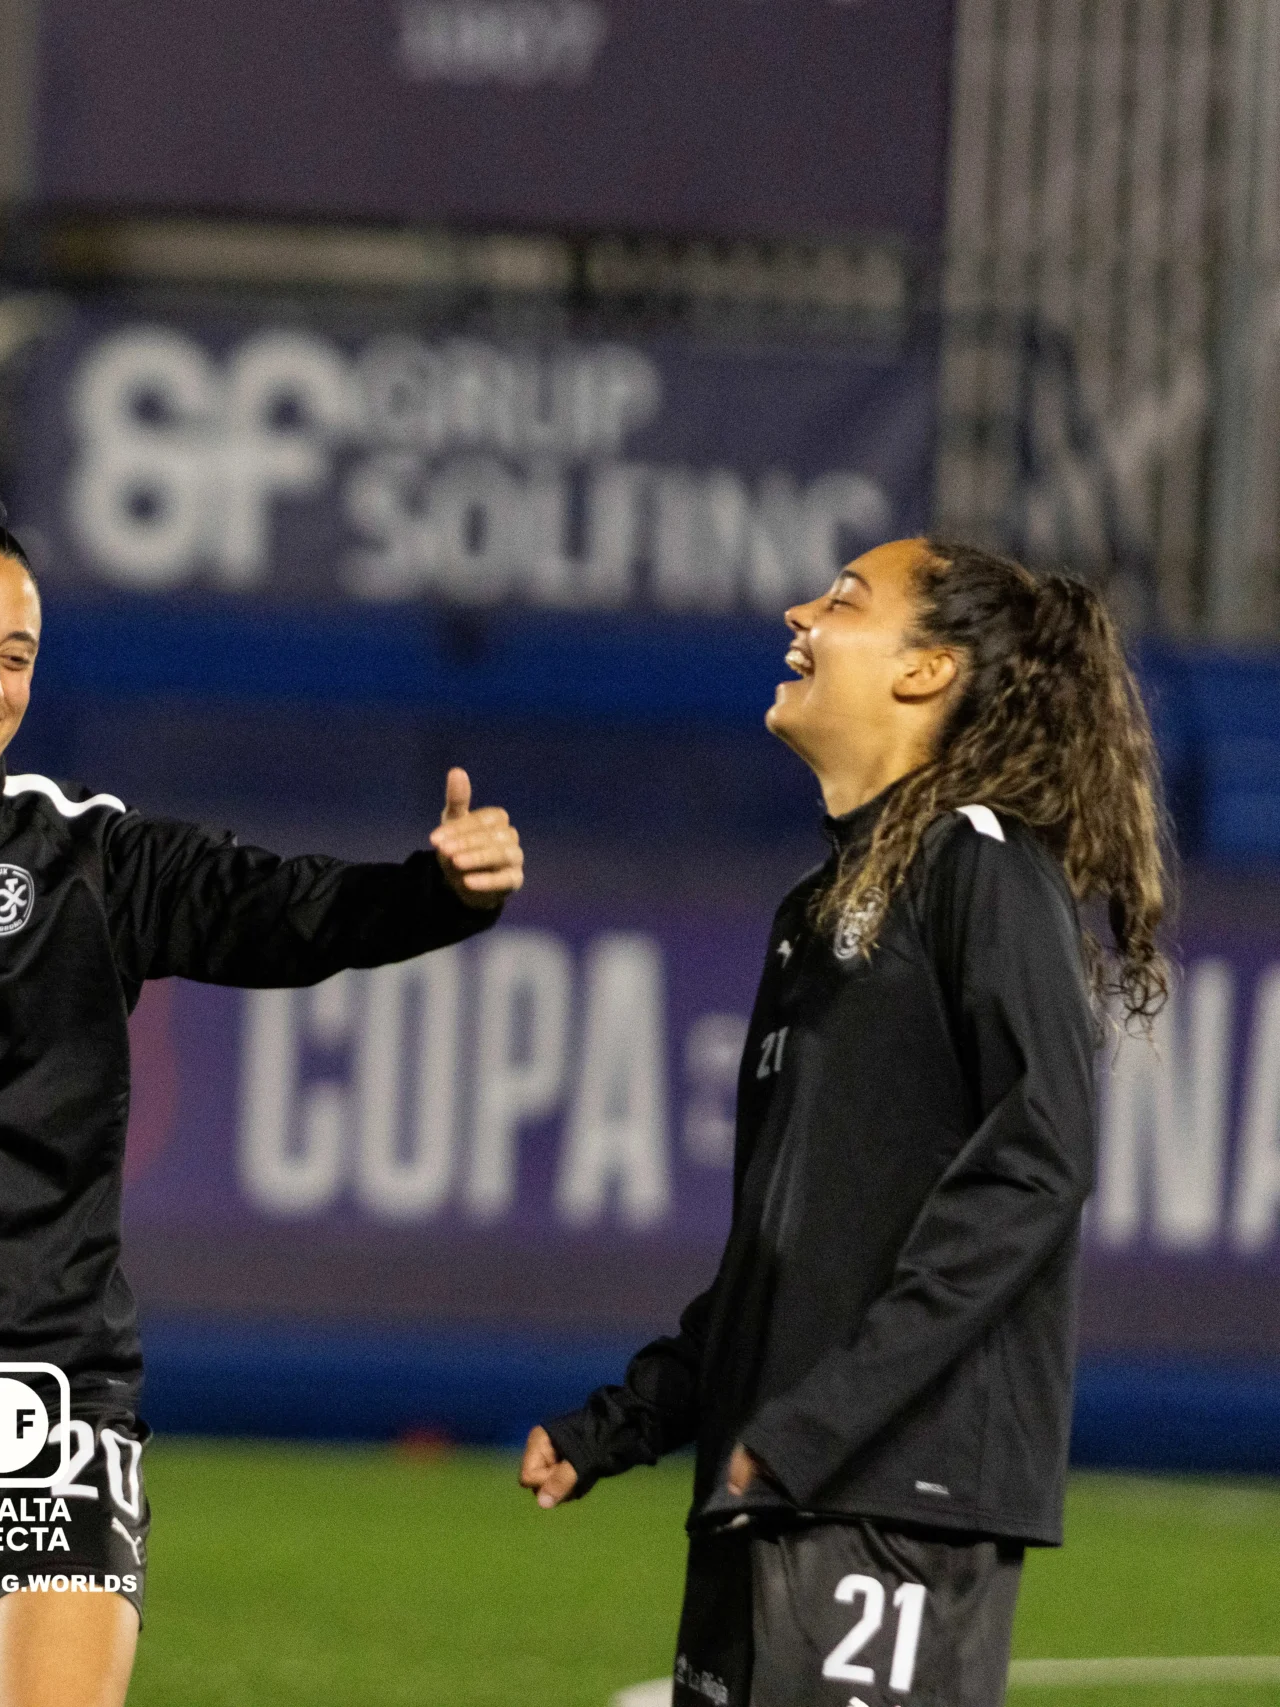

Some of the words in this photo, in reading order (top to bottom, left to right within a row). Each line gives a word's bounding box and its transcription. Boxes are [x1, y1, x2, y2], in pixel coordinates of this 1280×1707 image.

[242, 934, 670, 1222] COPA
[757, 1026, 789, 1079] 21
[47, 1420, 143, 1519] 20
[823, 1573, 926, 1693] 21
